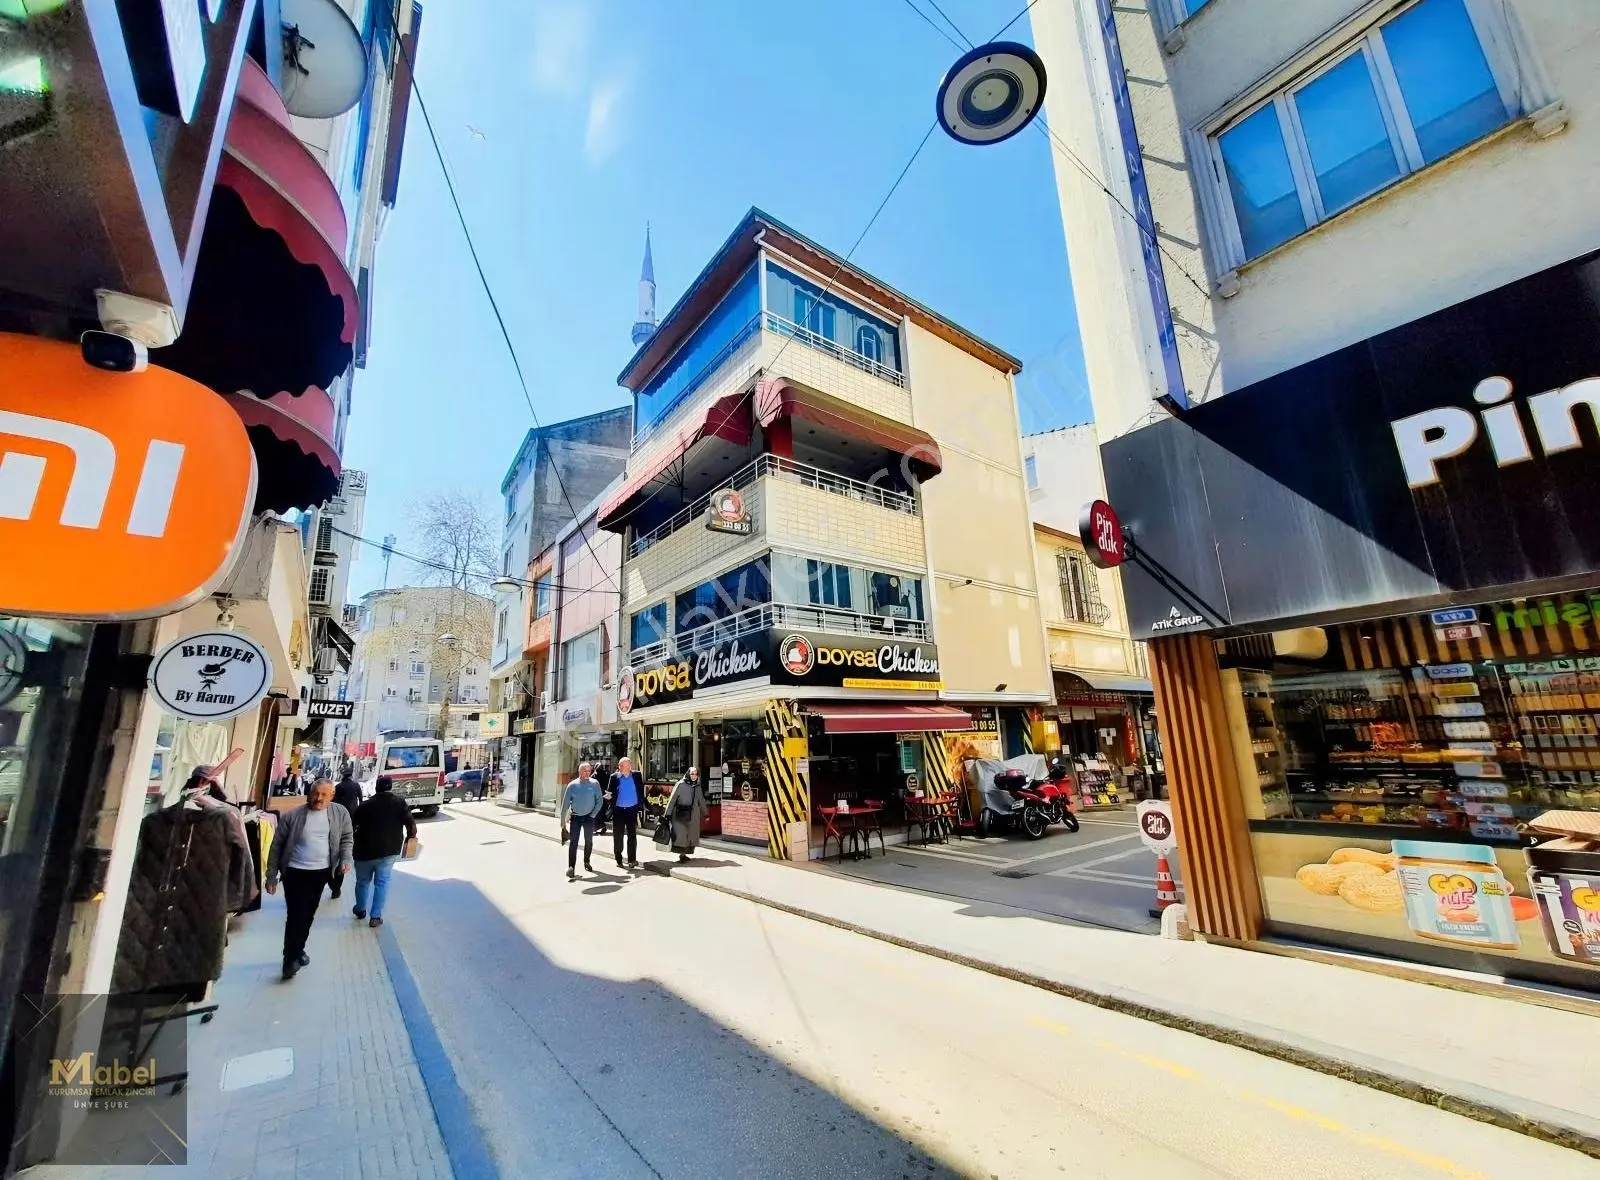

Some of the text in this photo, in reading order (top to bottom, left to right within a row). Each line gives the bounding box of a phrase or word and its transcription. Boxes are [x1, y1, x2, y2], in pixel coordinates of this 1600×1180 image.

[1096, 513, 1113, 535] Pin
[1173, 615, 1203, 627] GRUP
[182, 644, 255, 664] BERBER
[694, 639, 761, 685] Chicken
[877, 644, 940, 675] Chicken
[174, 689, 236, 705] By Harun
[309, 702, 352, 716] KUZEY
